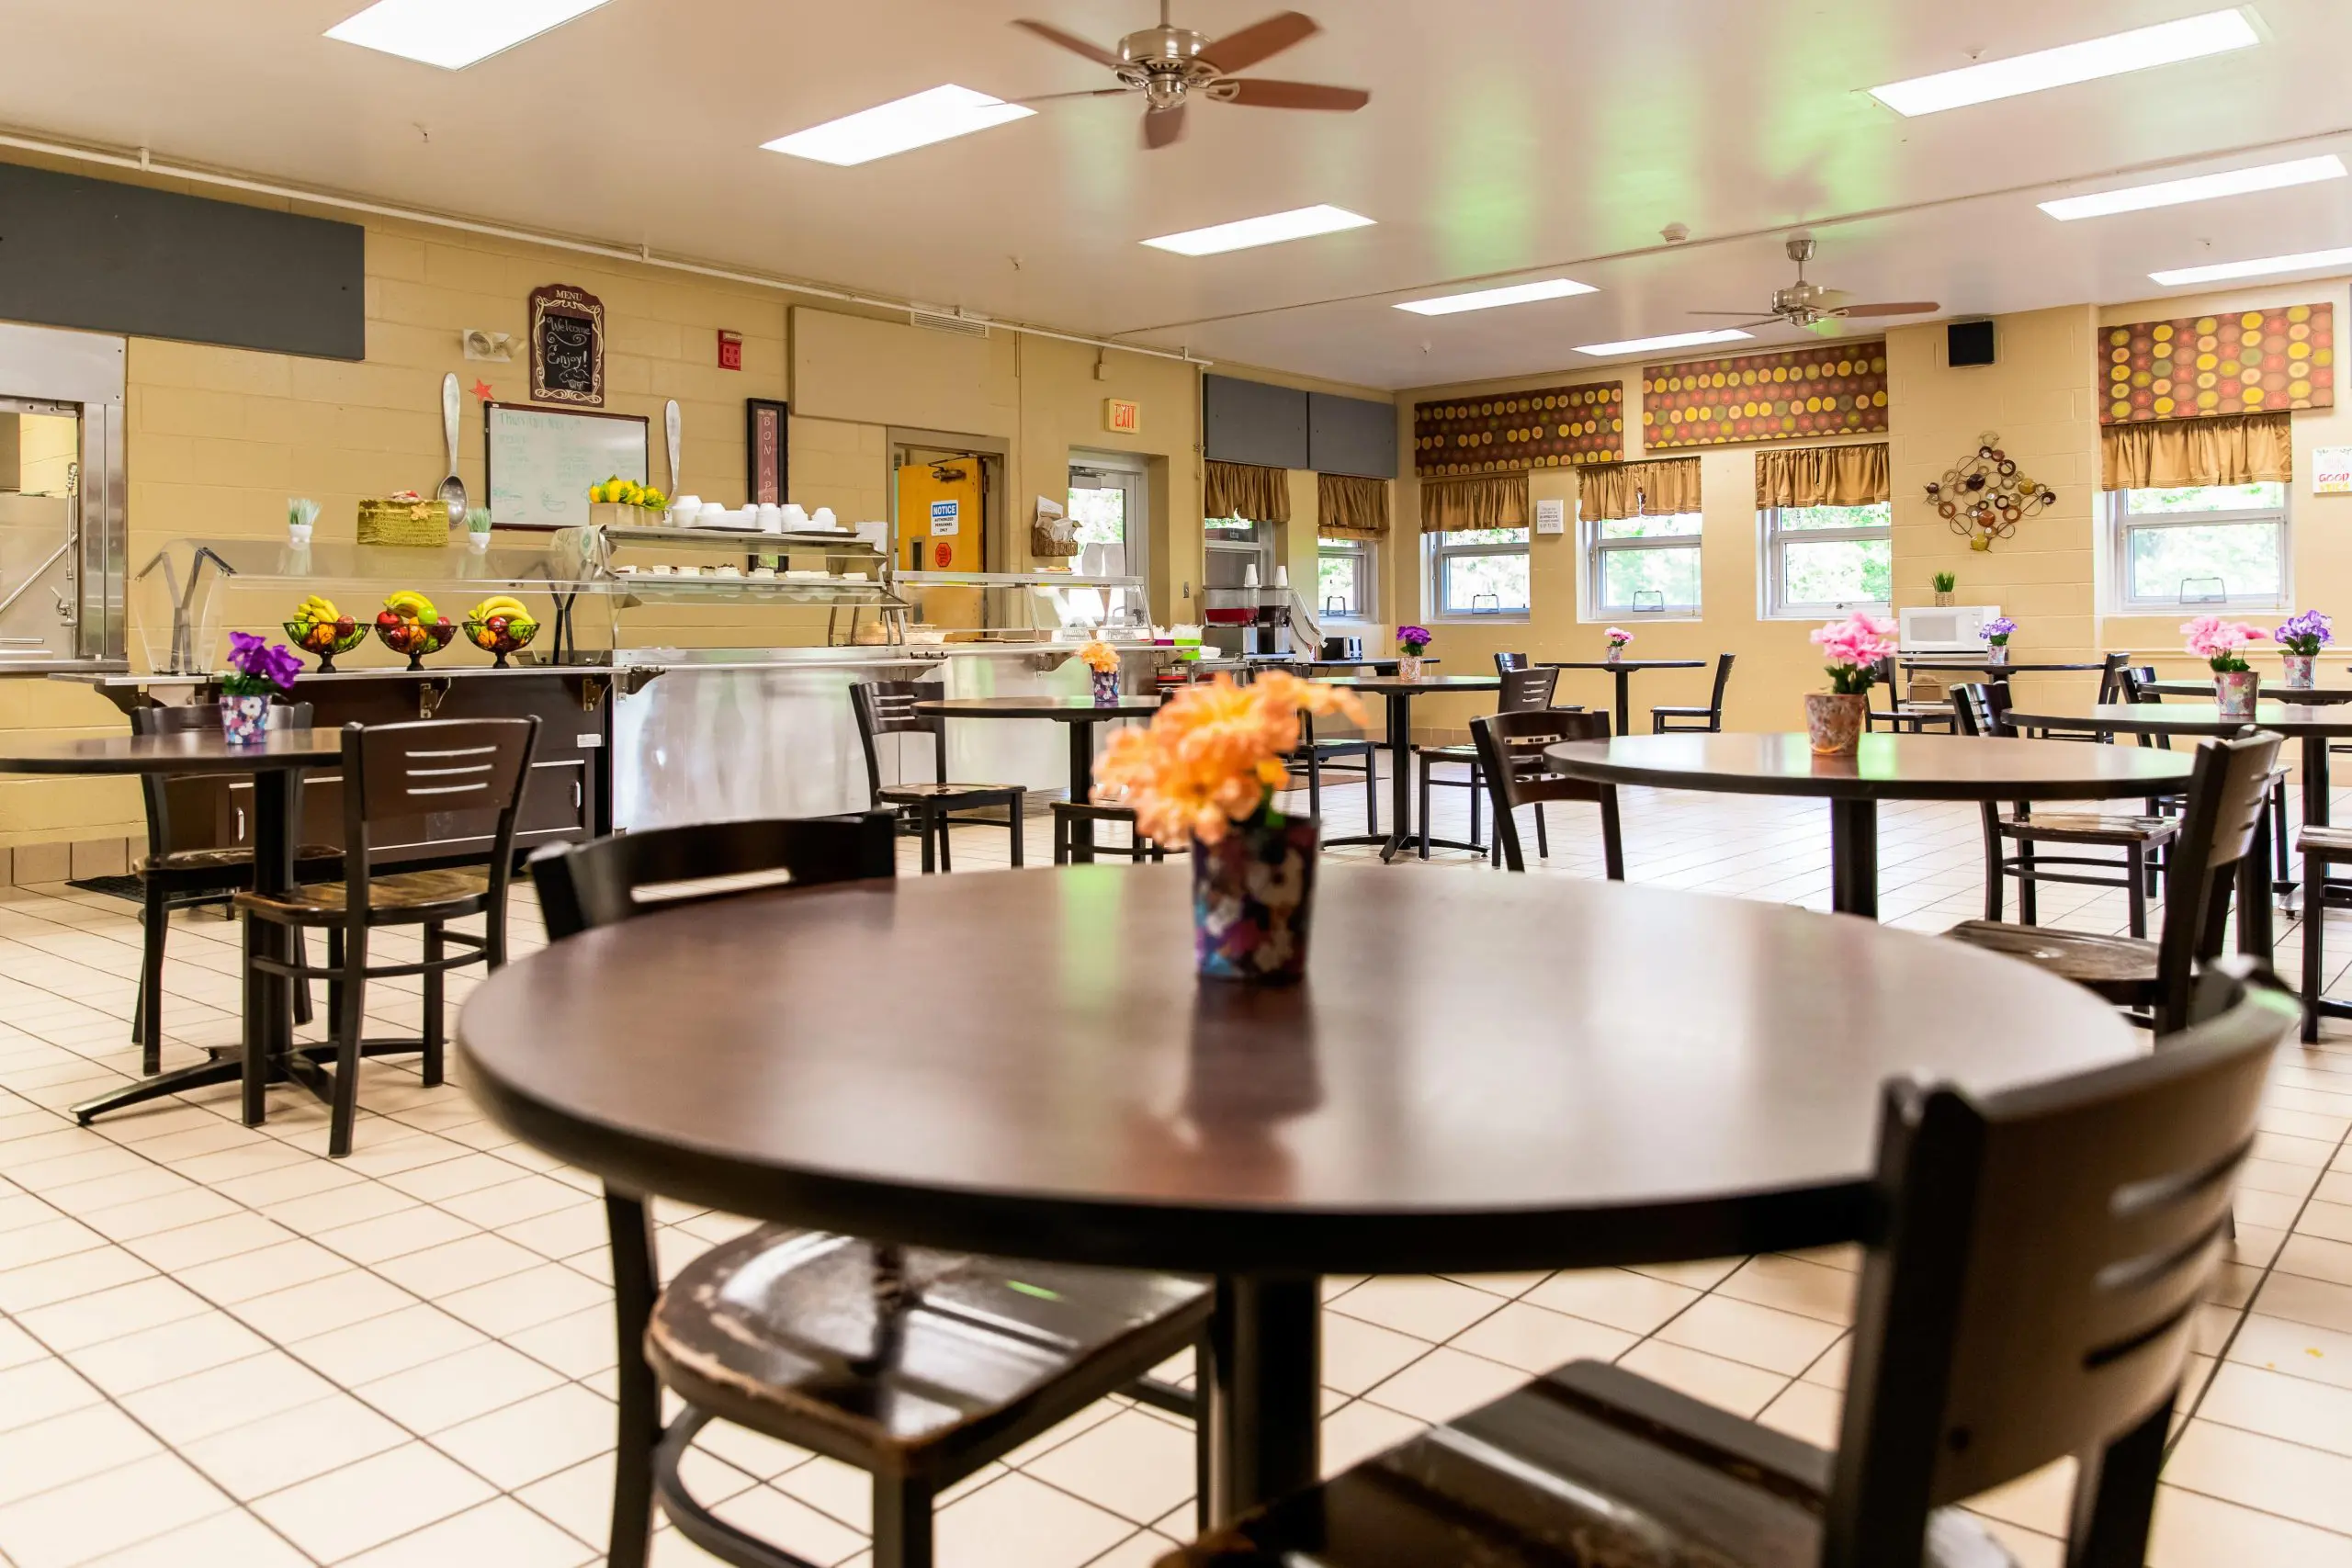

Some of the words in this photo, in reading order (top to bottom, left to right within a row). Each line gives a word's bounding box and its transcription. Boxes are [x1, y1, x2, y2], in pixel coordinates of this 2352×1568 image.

[556, 290, 582, 301] MENU
[547, 317, 591, 334] Welcome
[547, 344, 587, 369] Enjoy!
[1114, 404, 1136, 428] EXIT
[763, 416, 772, 456] BON
[2319, 473, 2349, 482] GOOD
[933, 505, 956, 515] NOTICE
